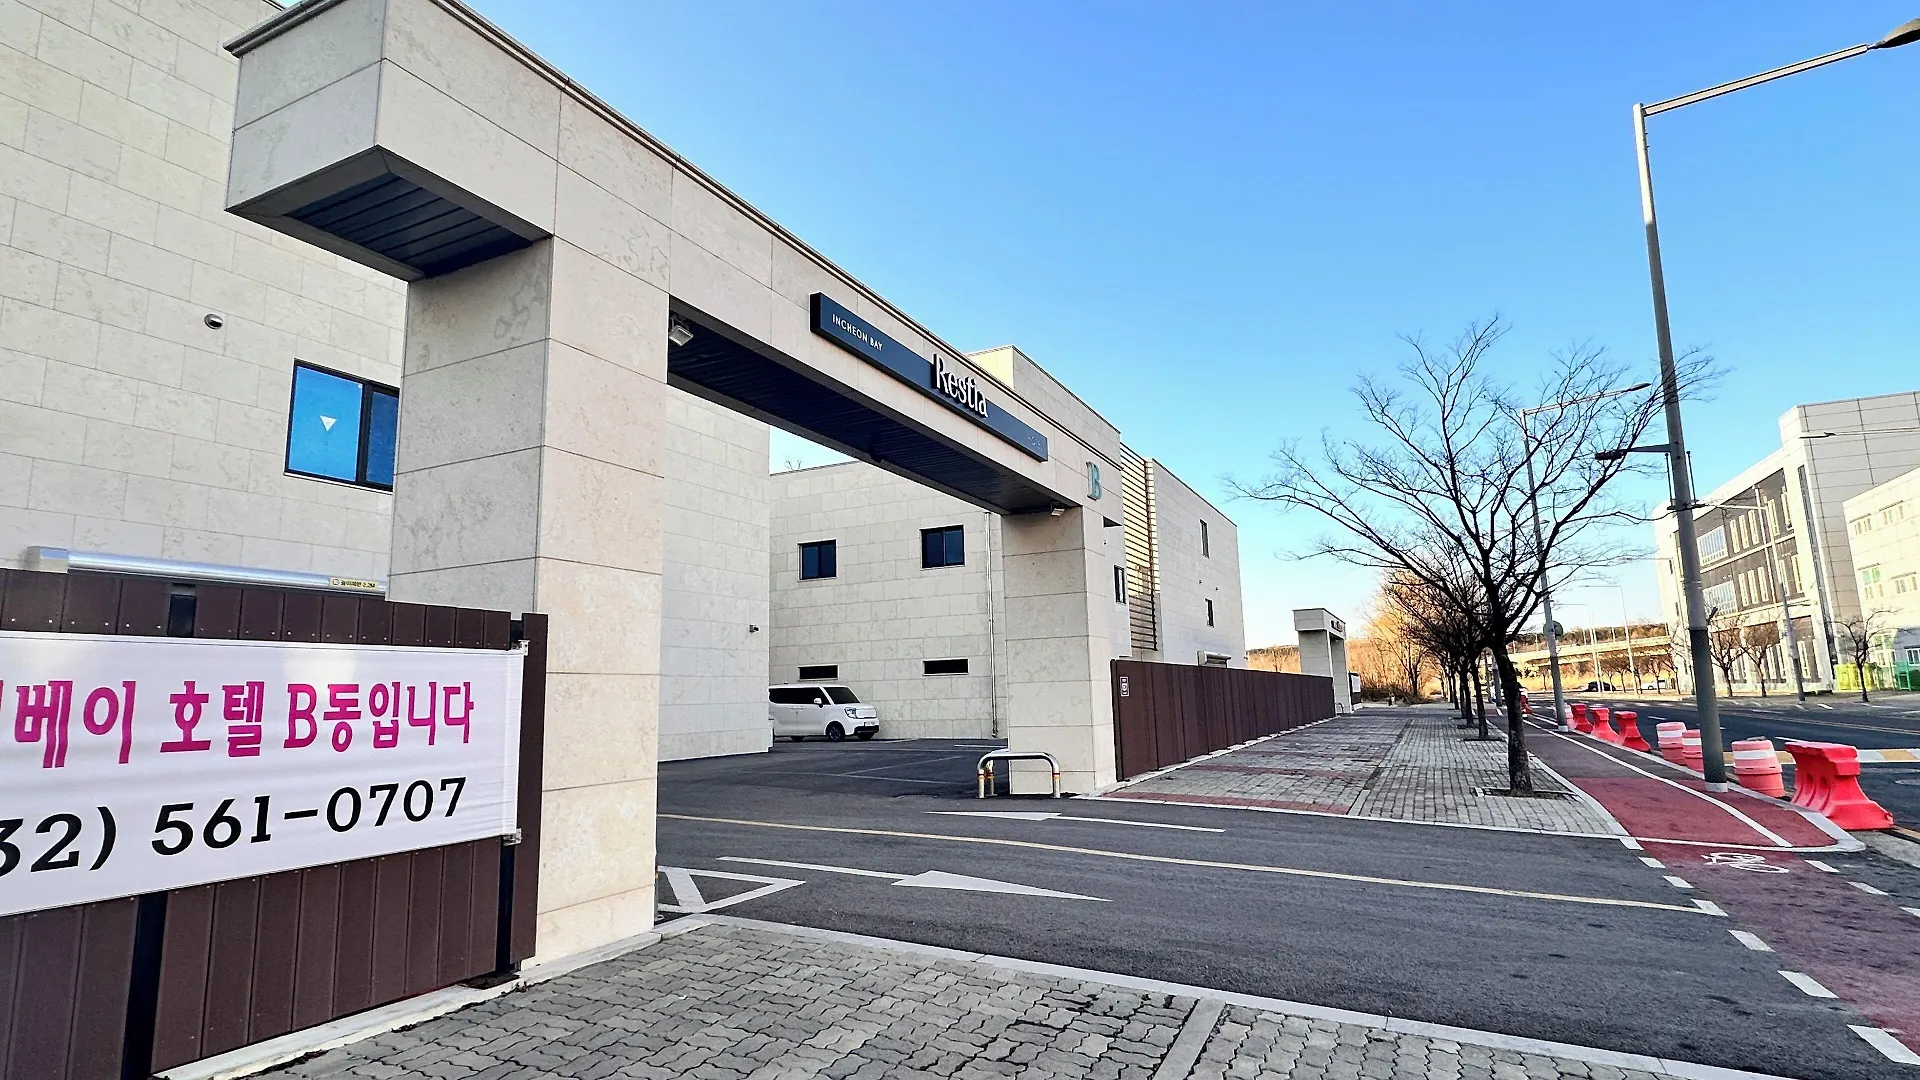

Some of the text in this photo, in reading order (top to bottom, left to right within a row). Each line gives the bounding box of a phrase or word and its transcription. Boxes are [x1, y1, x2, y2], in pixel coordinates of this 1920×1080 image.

[832, 313, 883, 351] INCHEON BAY
[932, 353, 988, 418] Restia
[1086, 461, 1102, 501] B
[0, 680, 474, 769] 베이 호텔 B동입니다
[151, 776, 467, 856] 561-0707
